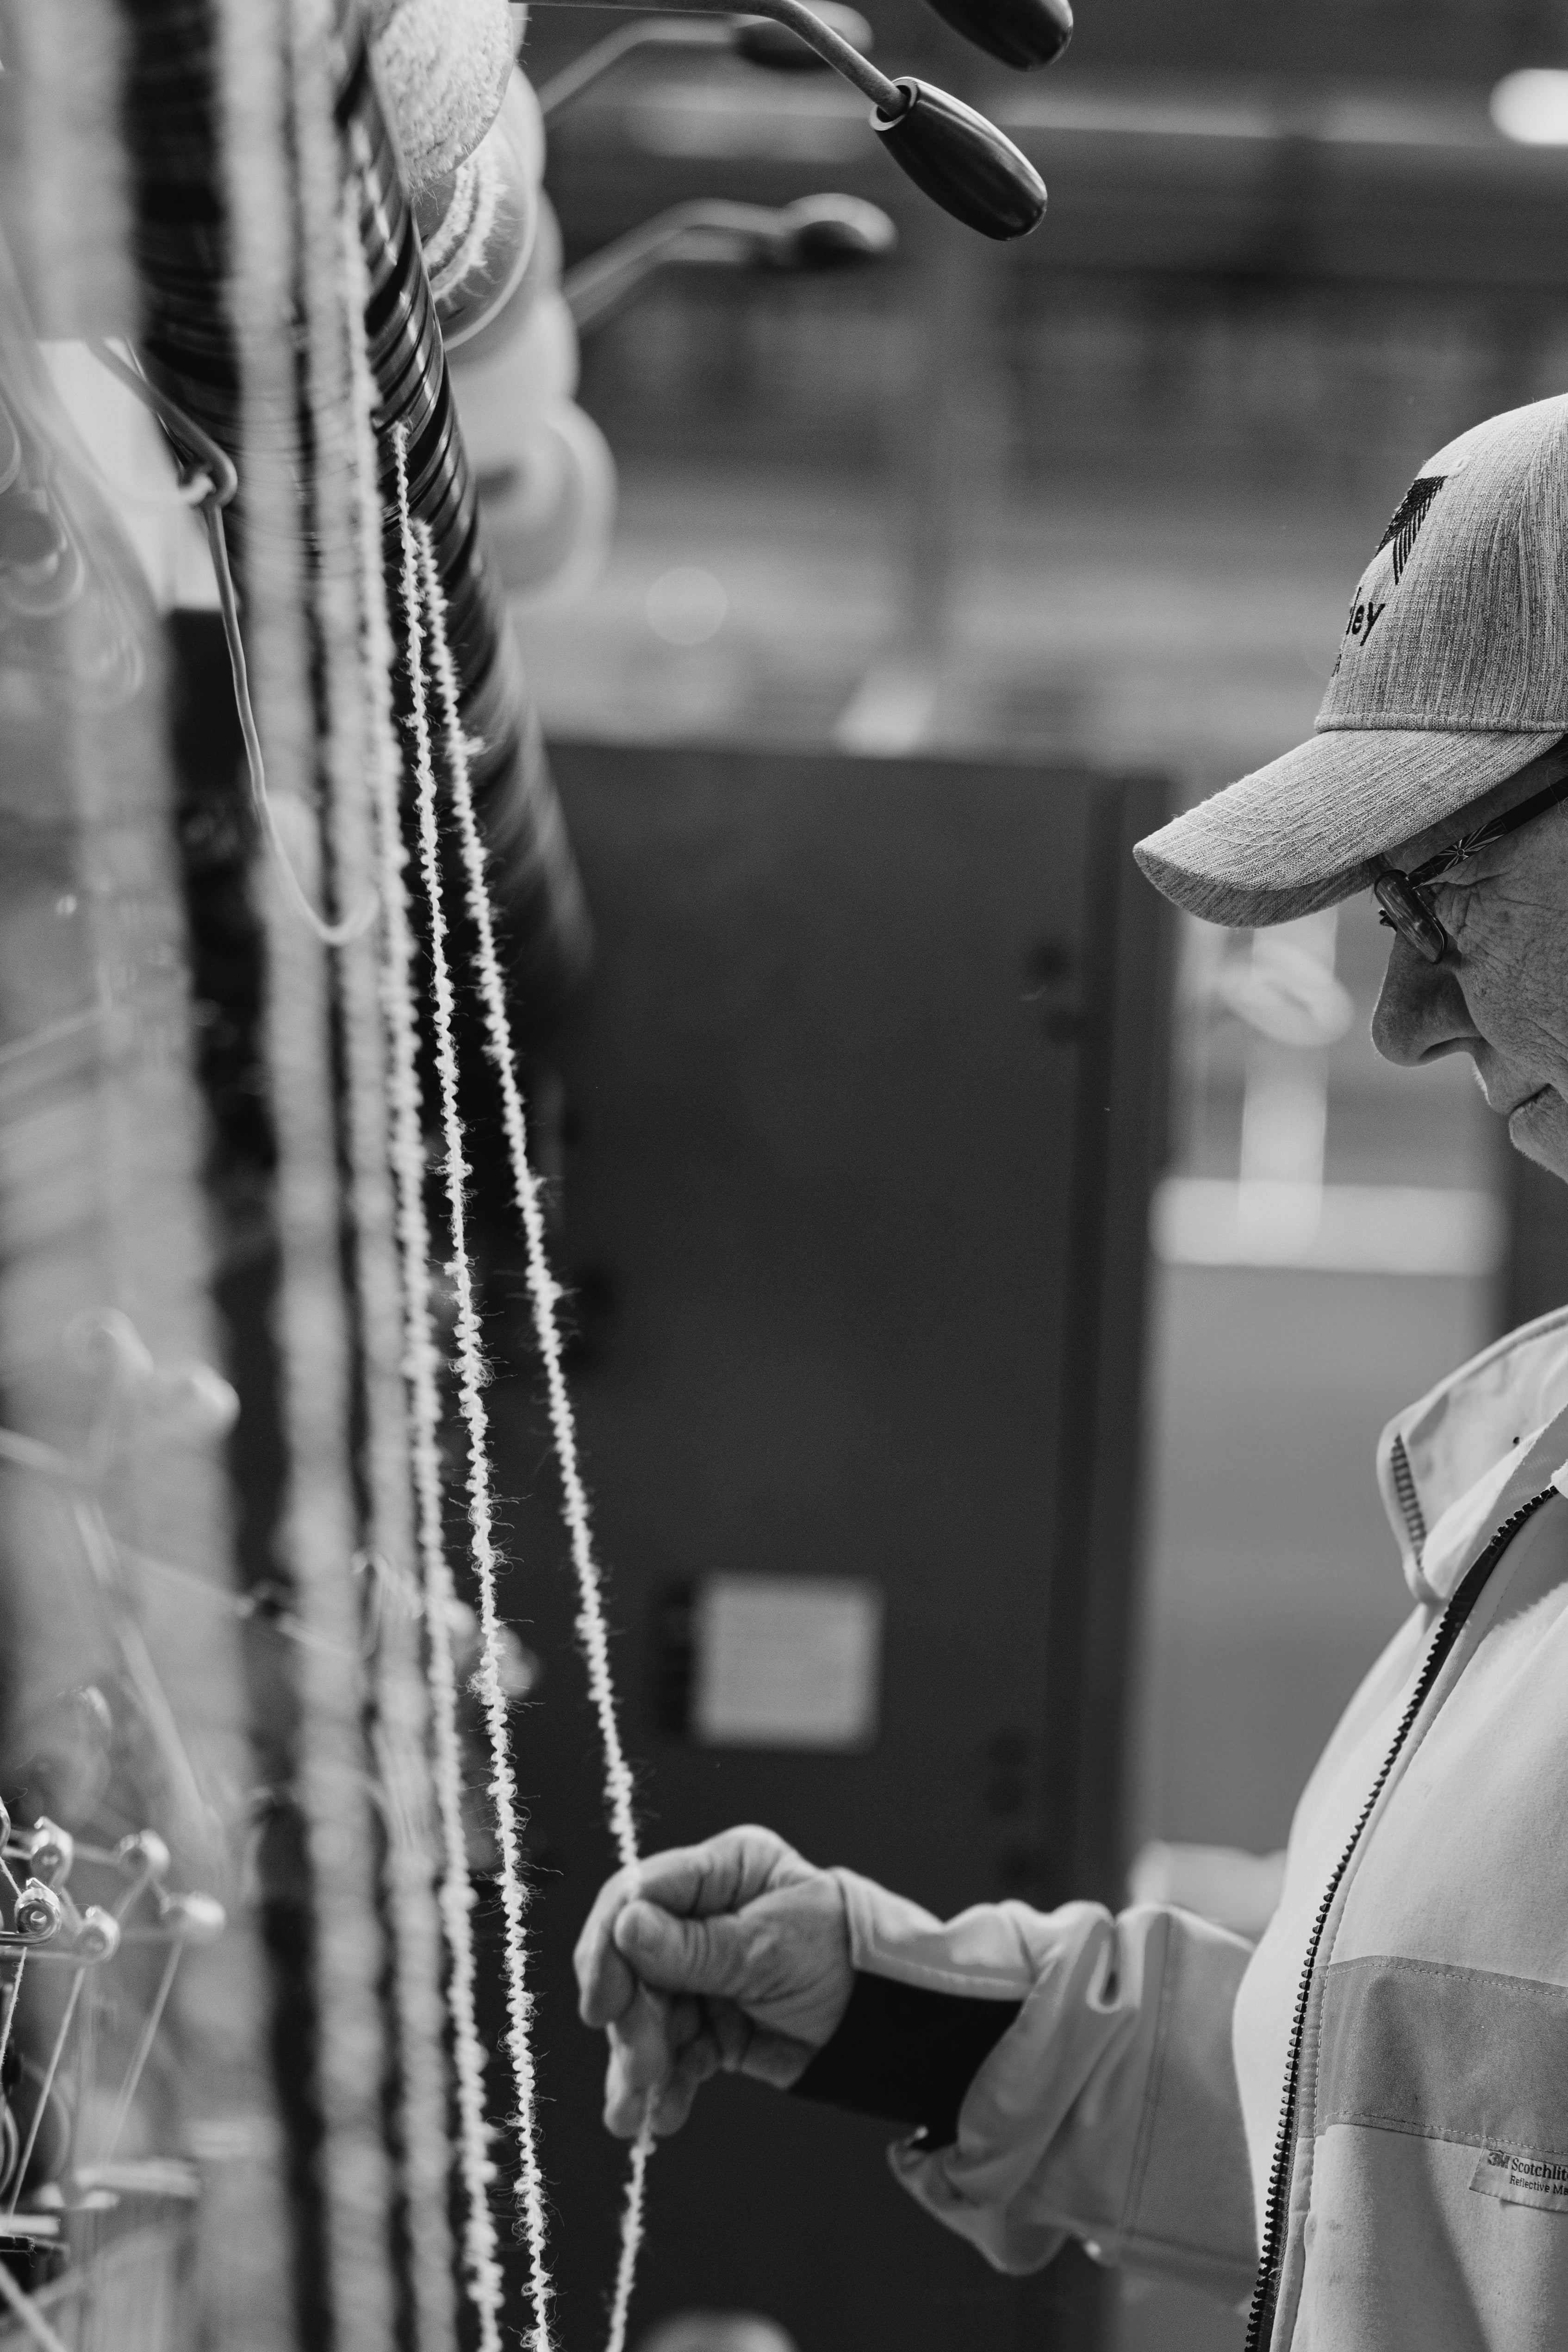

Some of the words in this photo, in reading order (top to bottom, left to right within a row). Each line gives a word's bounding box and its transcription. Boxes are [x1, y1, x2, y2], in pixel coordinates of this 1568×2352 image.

[1345, 586, 1386, 647] ley
[1487, 2152, 1511, 2169] 3M
[1512, 2157, 1568, 2181] Scotchlit
[1510, 2175, 1550, 2193] Reflective
[1552, 2184, 1568, 2196] Ma
